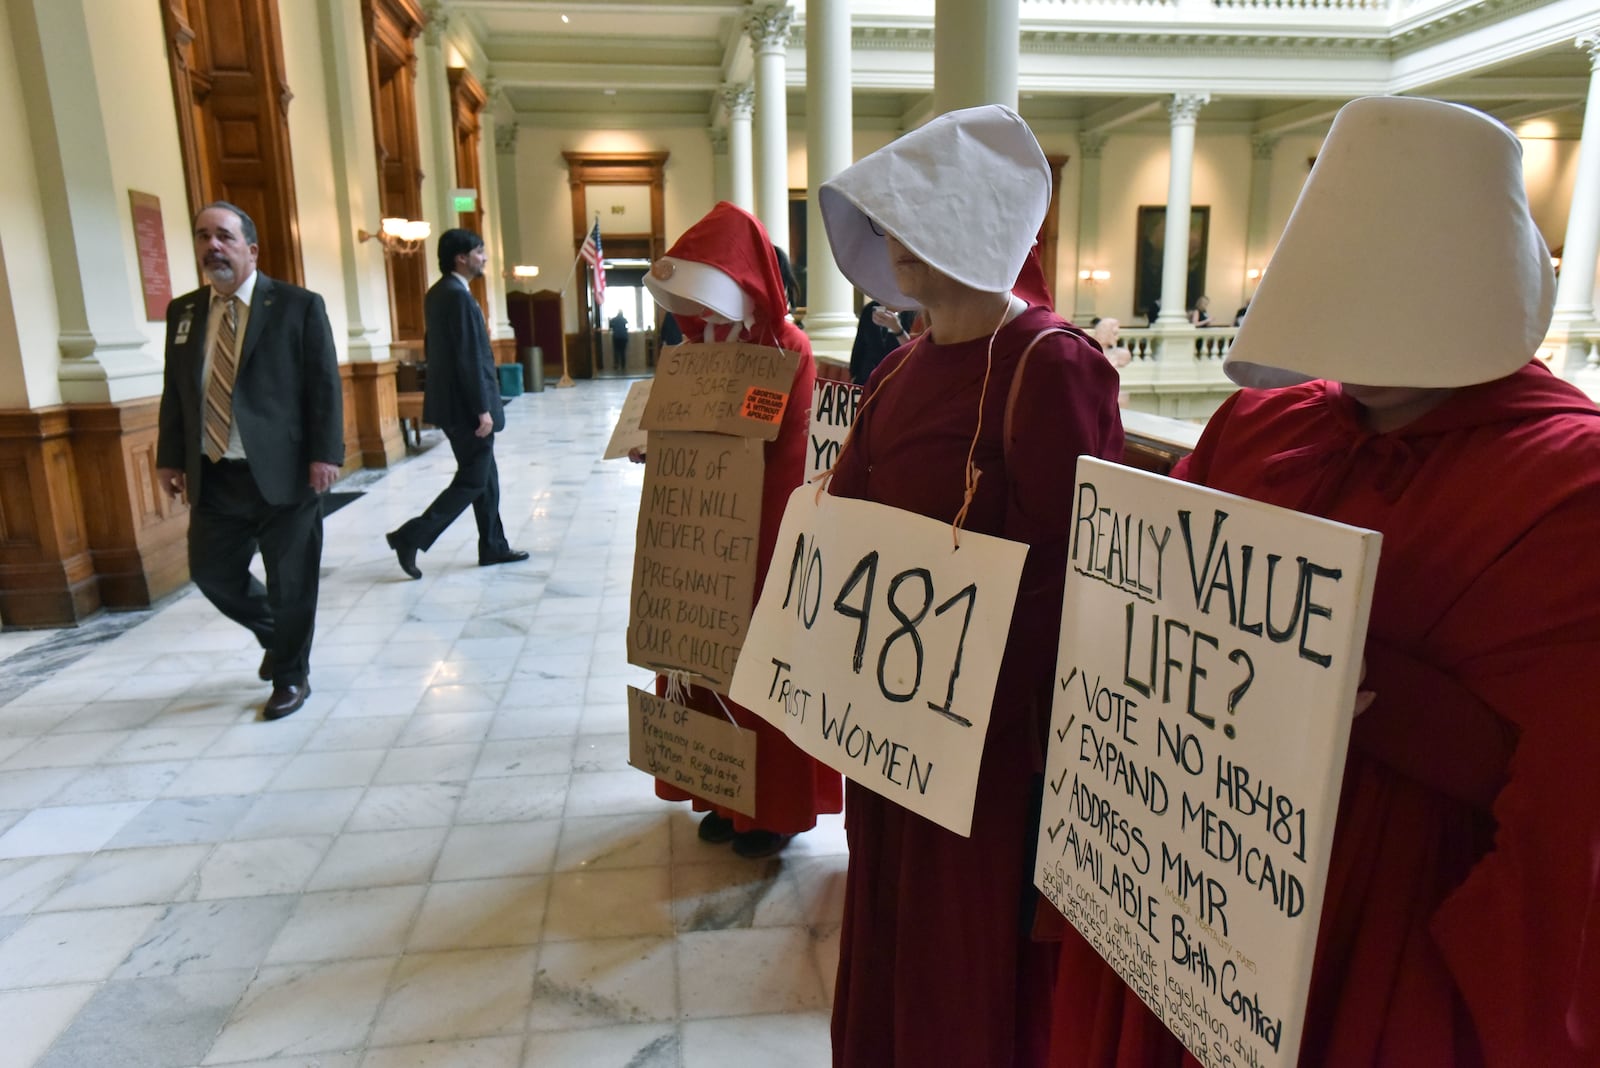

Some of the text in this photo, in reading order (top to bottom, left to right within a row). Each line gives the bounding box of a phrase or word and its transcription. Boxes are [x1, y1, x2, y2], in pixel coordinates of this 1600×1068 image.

[690, 376, 740, 397] SCARE
[752, 389, 783, 401] ABORTION
[758, 397, 783, 408] DEMAND
[703, 401, 742, 418] MEN
[747, 410, 774, 421] APOLOGY
[753, 404, 779, 415] WITHOUT
[656, 448, 699, 478] 100%
[812, 434, 843, 470] YO
[651, 485, 746, 522] MEN WILL
[643, 518, 754, 565] NEVER GET
[1072, 482, 1342, 668] REALLY VALUE
[636, 589, 739, 637] OUR BODIES
[782, 532, 977, 727] NO 481
[636, 620, 672, 656] OUR
[1123, 602, 1255, 740] LIFE?
[822, 692, 933, 795] WOMEN
[1082, 670, 1306, 863] VOTE NO HB481
[1080, 724, 1304, 918] EXPAND MEDICAID
[1056, 860, 1073, 891] Gun
[1069, 772, 1228, 937] ADDRESS MMR
[1063, 823, 1282, 1054] AVAILABLE Birth Control
[1106, 931, 1159, 997] affordable
